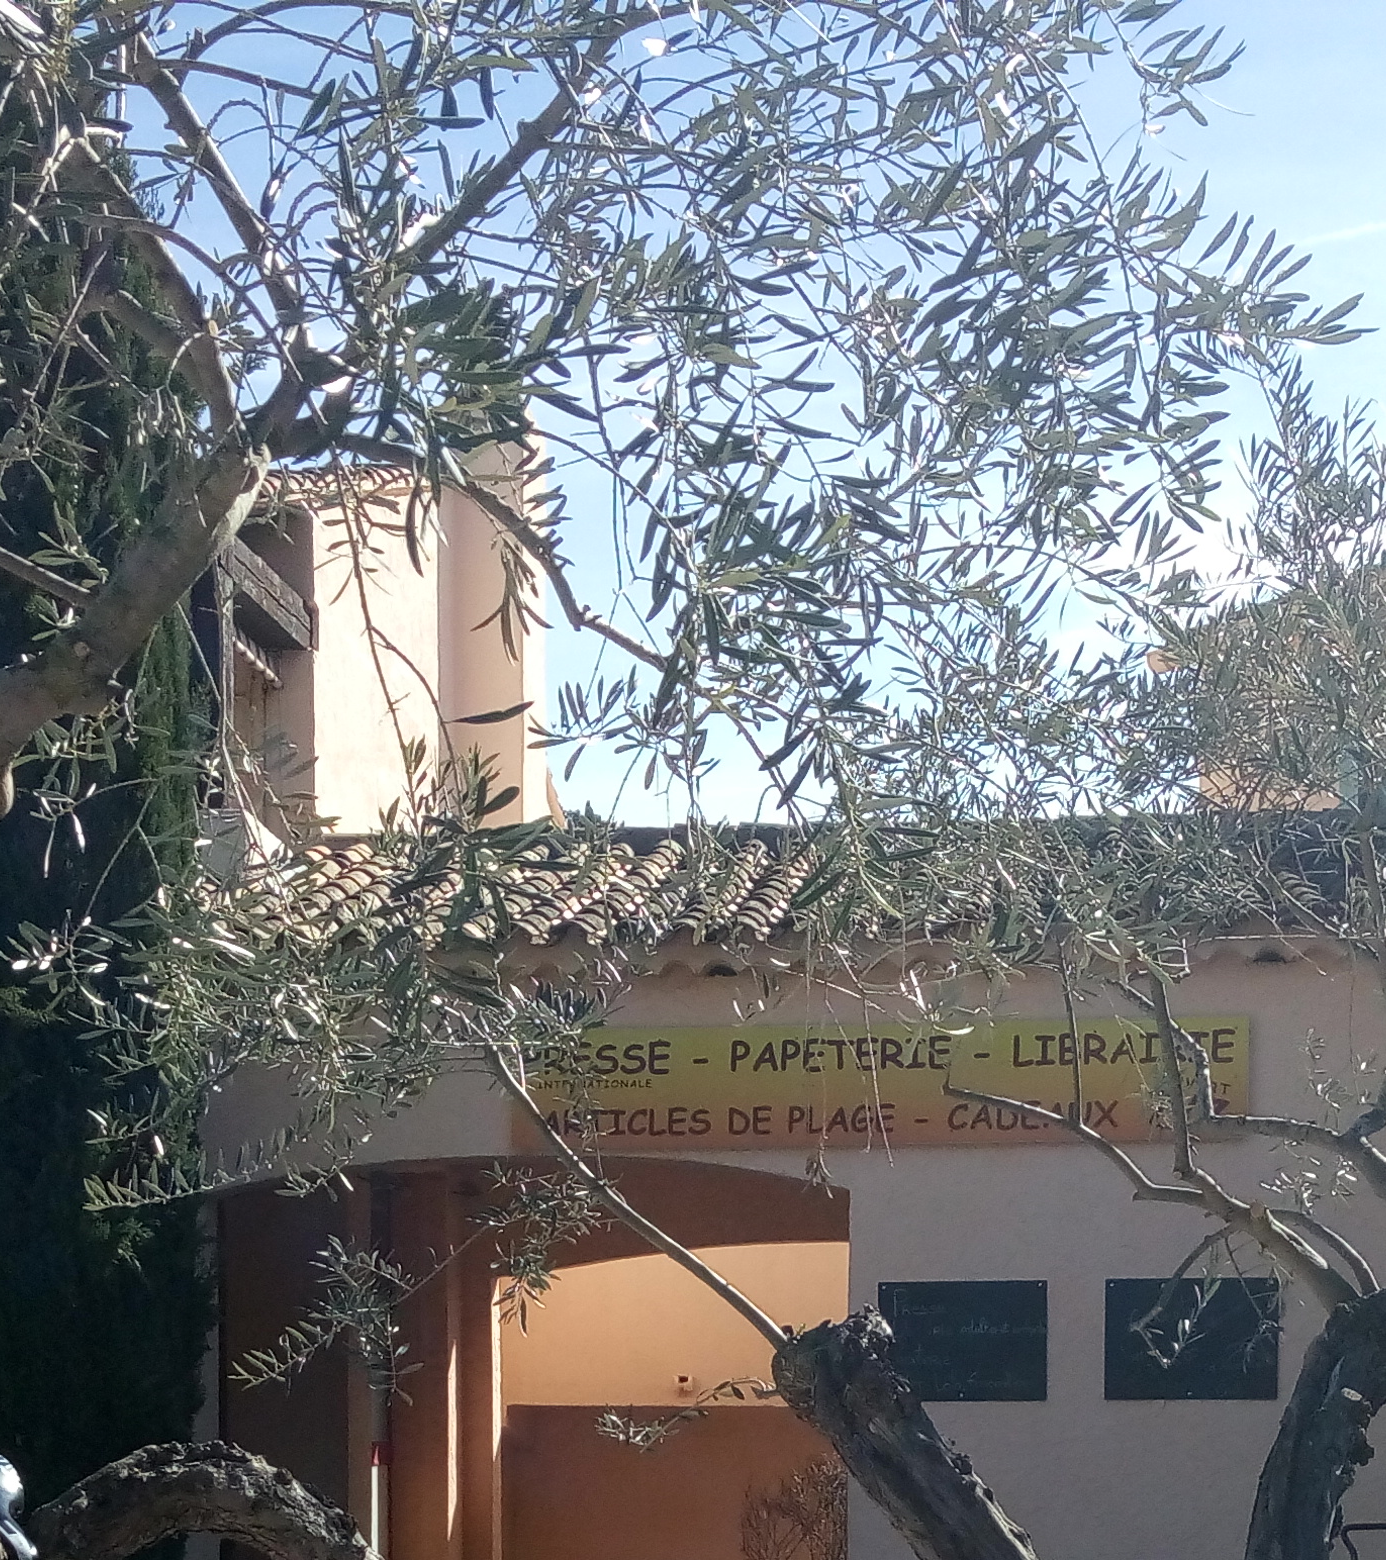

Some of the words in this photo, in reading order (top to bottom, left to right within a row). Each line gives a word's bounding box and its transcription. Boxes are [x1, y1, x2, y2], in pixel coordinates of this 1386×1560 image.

[730, 1035, 953, 1072] PAPETERIE
[1012, 1028, 1237, 1068] LIBRAIIE
[537, 1078, 654, 1090] INTEATIONALE
[545, 1105, 712, 1137] ARTICLES
[729, 1105, 773, 1136] DE
[788, 1103, 896, 1134] PLAGE
